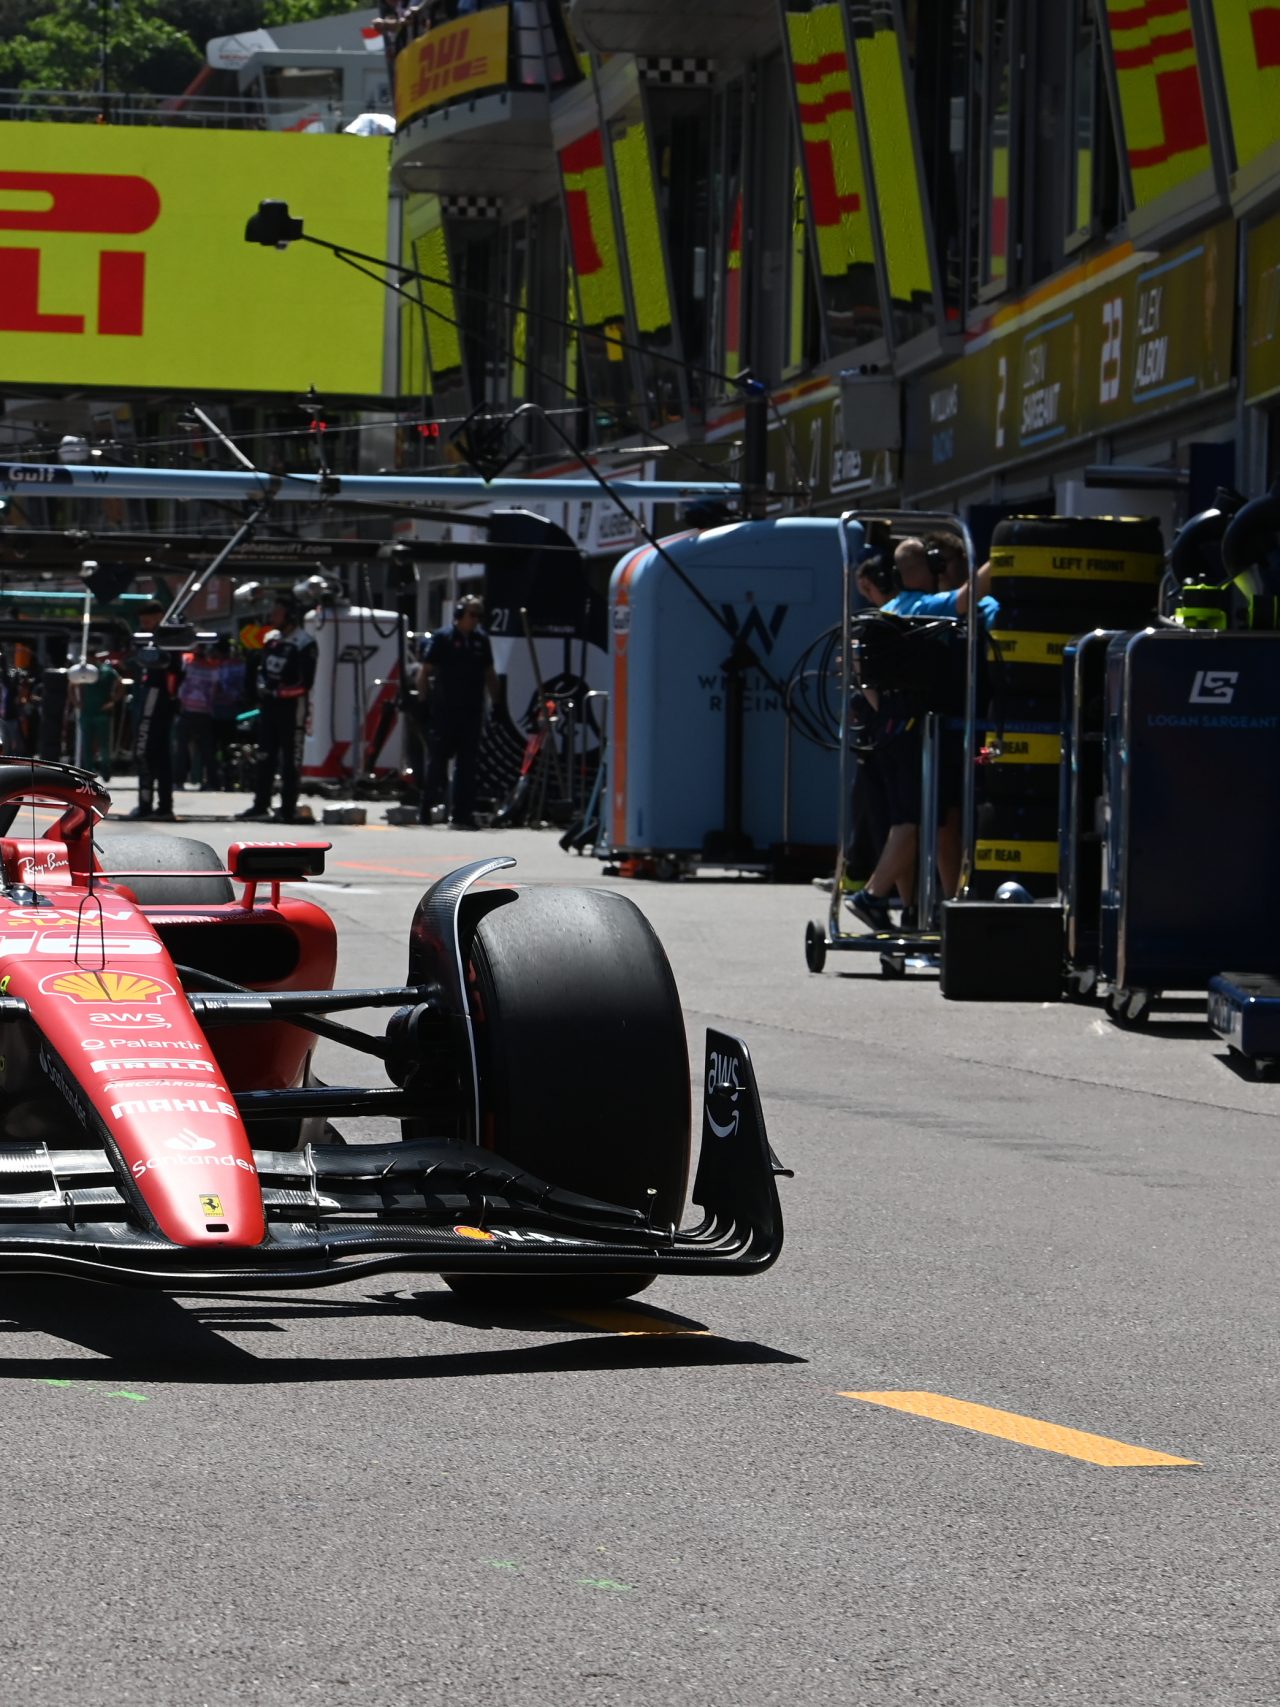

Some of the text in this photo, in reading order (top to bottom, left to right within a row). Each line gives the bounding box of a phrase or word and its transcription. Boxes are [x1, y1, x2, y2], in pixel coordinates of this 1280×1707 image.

[1100, 297, 1122, 405] 23
[995, 355, 1008, 448] 2
[8, 466, 56, 483] Gulf
[1052, 556, 1125, 573] LEFT FRONT
[491, 609, 510, 631] 21
[697, 674, 810, 690] WILIAS
[1147, 714, 1200, 727] LOGAN
[8, 918, 102, 928] PLAY
[89, 1012, 166, 1023] aws
[108, 1038, 203, 1051] Palantir
[90, 1057, 216, 1073] PIRELLI
[110, 1098, 239, 1120] MAHLE
[131, 1153, 258, 1179] Santander
